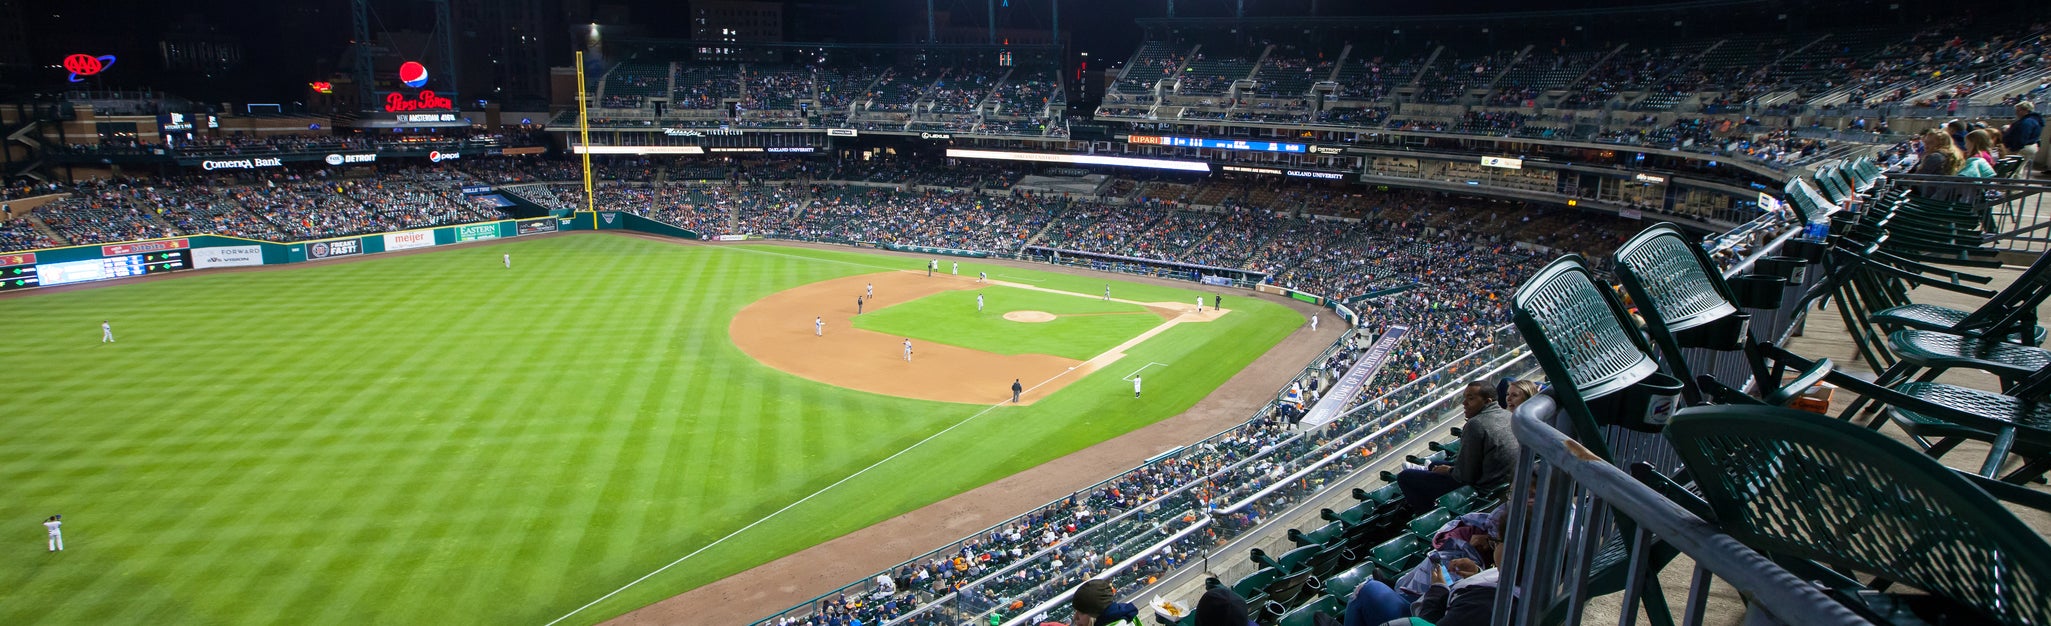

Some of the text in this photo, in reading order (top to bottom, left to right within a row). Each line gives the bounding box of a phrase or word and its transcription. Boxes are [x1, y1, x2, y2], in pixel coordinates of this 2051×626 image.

[68, 55, 99, 73] AAA
[1132, 136, 1158, 144] LIPARI
[345, 154, 376, 163] DETROIT
[441, 152, 460, 160] pepsi
[254, 157, 282, 167] Bank
[1312, 171, 1344, 180] UNIVERSITY
[460, 224, 495, 235] EASTERN
[395, 233, 424, 243] meijer
